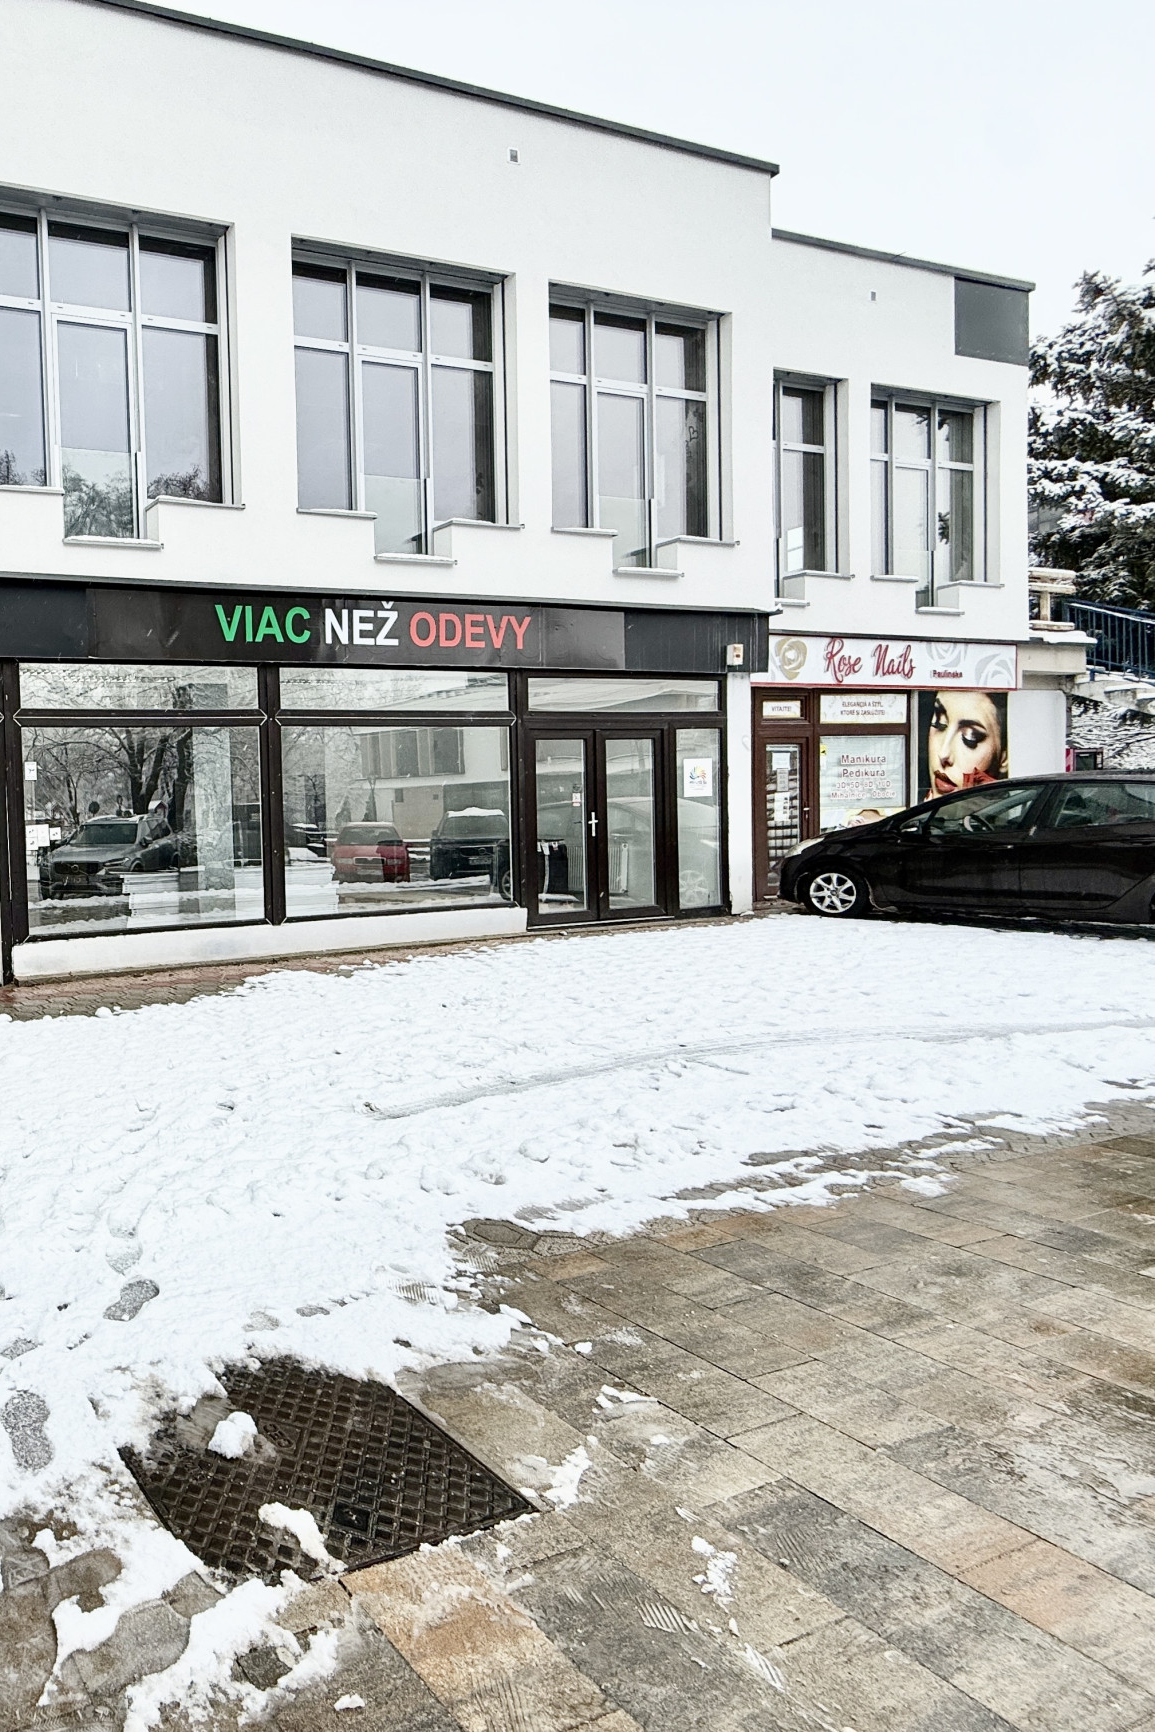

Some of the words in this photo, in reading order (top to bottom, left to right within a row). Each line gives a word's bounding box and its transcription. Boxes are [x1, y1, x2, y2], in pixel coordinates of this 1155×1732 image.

[214, 604, 311, 644] VIAC
[324, 600, 400, 647] NEŽ
[409, 611, 532, 650] ODEVY
[825, 637, 862, 684] Rose
[873, 643, 917, 680] Nails
